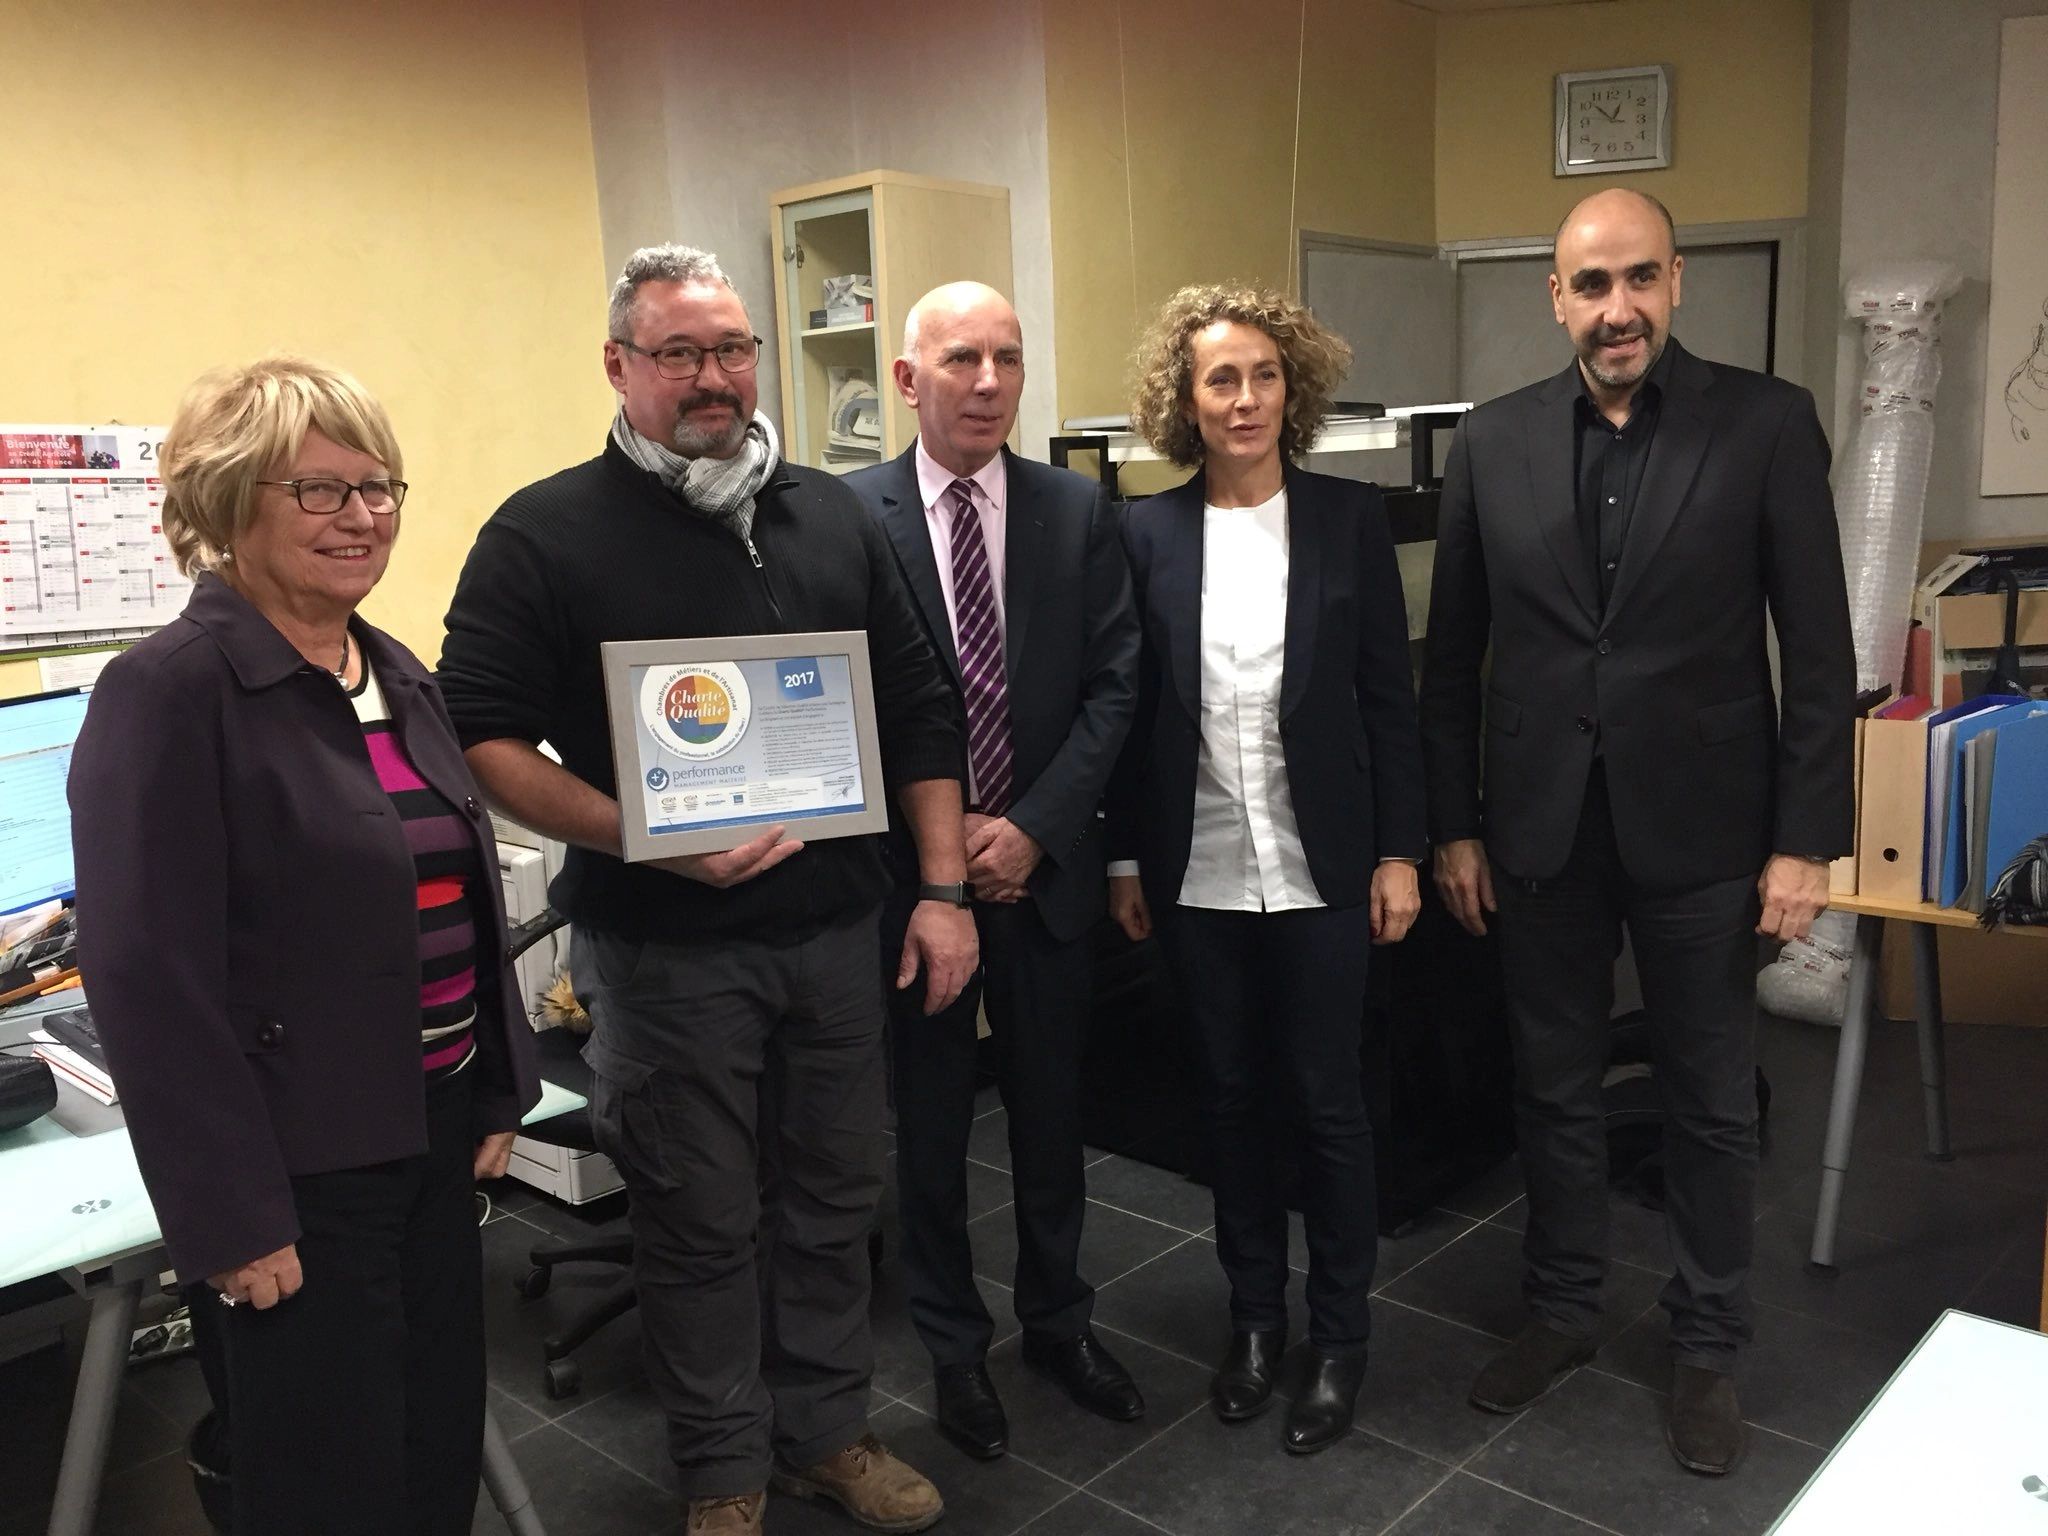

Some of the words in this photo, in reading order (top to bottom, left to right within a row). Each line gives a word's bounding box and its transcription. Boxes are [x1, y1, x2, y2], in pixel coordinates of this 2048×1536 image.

[1606, 89, 1620, 100] 12
[1580, 101, 1592, 111] 10
[1636, 97, 1647, 106] 2
[1636, 114, 1647, 124] 3
[6, 439, 70, 450] Bienvenue
[676, 667, 702, 676] Métiers
[783, 671, 815, 688] 2017
[670, 689, 722, 705] Charte
[670, 700, 726, 723] Qualité
[672, 764, 745, 783] performance
